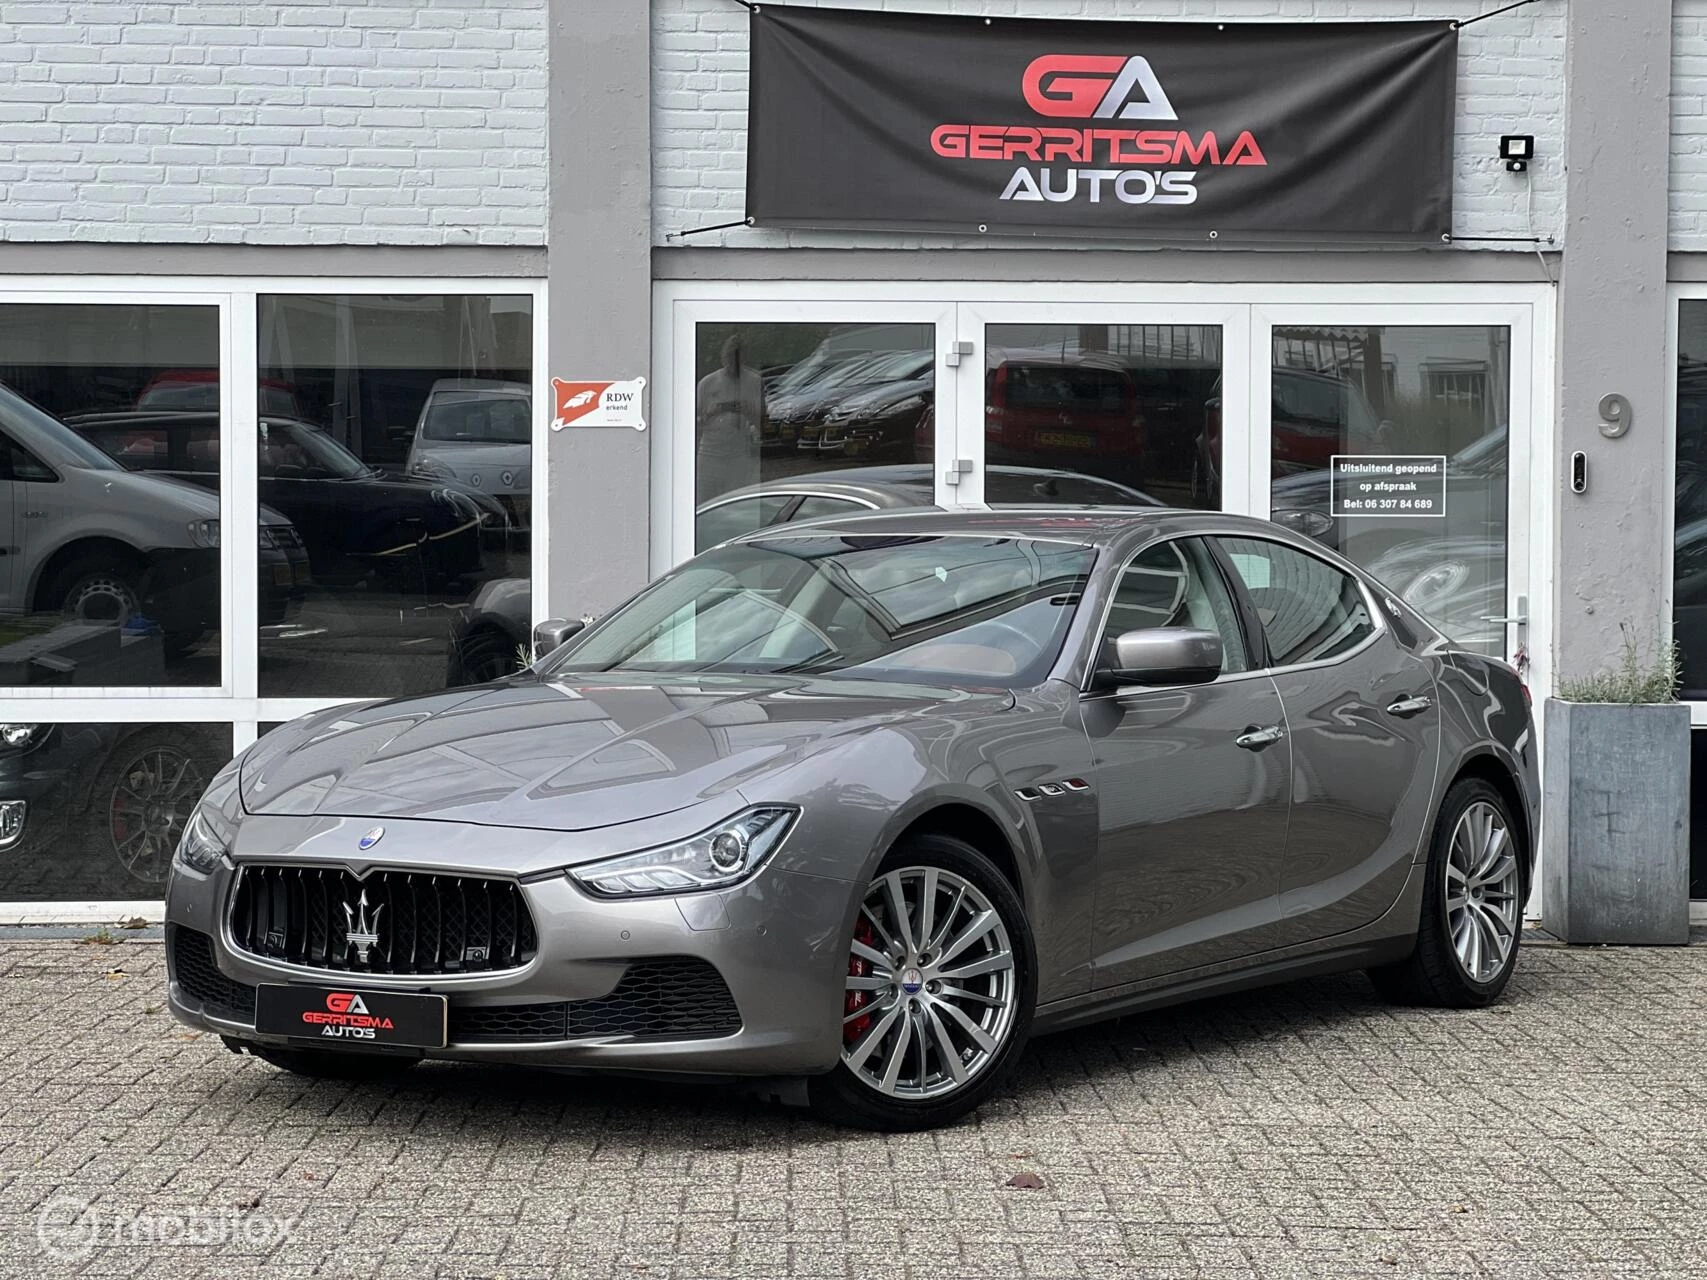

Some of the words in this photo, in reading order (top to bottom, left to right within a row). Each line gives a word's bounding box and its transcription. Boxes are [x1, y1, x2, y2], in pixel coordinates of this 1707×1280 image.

[1022, 54, 1179, 121] GA
[930, 124, 1268, 165] GERRITSMA
[999, 166, 1198, 205] AUTO'S
[606, 393, 634, 402] RDW
[1598, 391, 1633, 440] 9
[1340, 463, 1393, 473] Uitsluitend
[1395, 463, 1437, 475] geopend
[1359, 483, 1372, 492] op
[1374, 482, 1417, 492] afspraak
[1343, 499, 1363, 509] Bel:
[1365, 499, 1377, 509] 06
[1379, 499, 1397, 509] 307
[1399, 499, 1412, 509] 84
[1414, 499, 1433, 509] 689
[326, 993, 369, 1014] GA
[302, 1012, 393, 1029] GERRITSMA
[321, 1025, 376, 1039] AUTO'S
